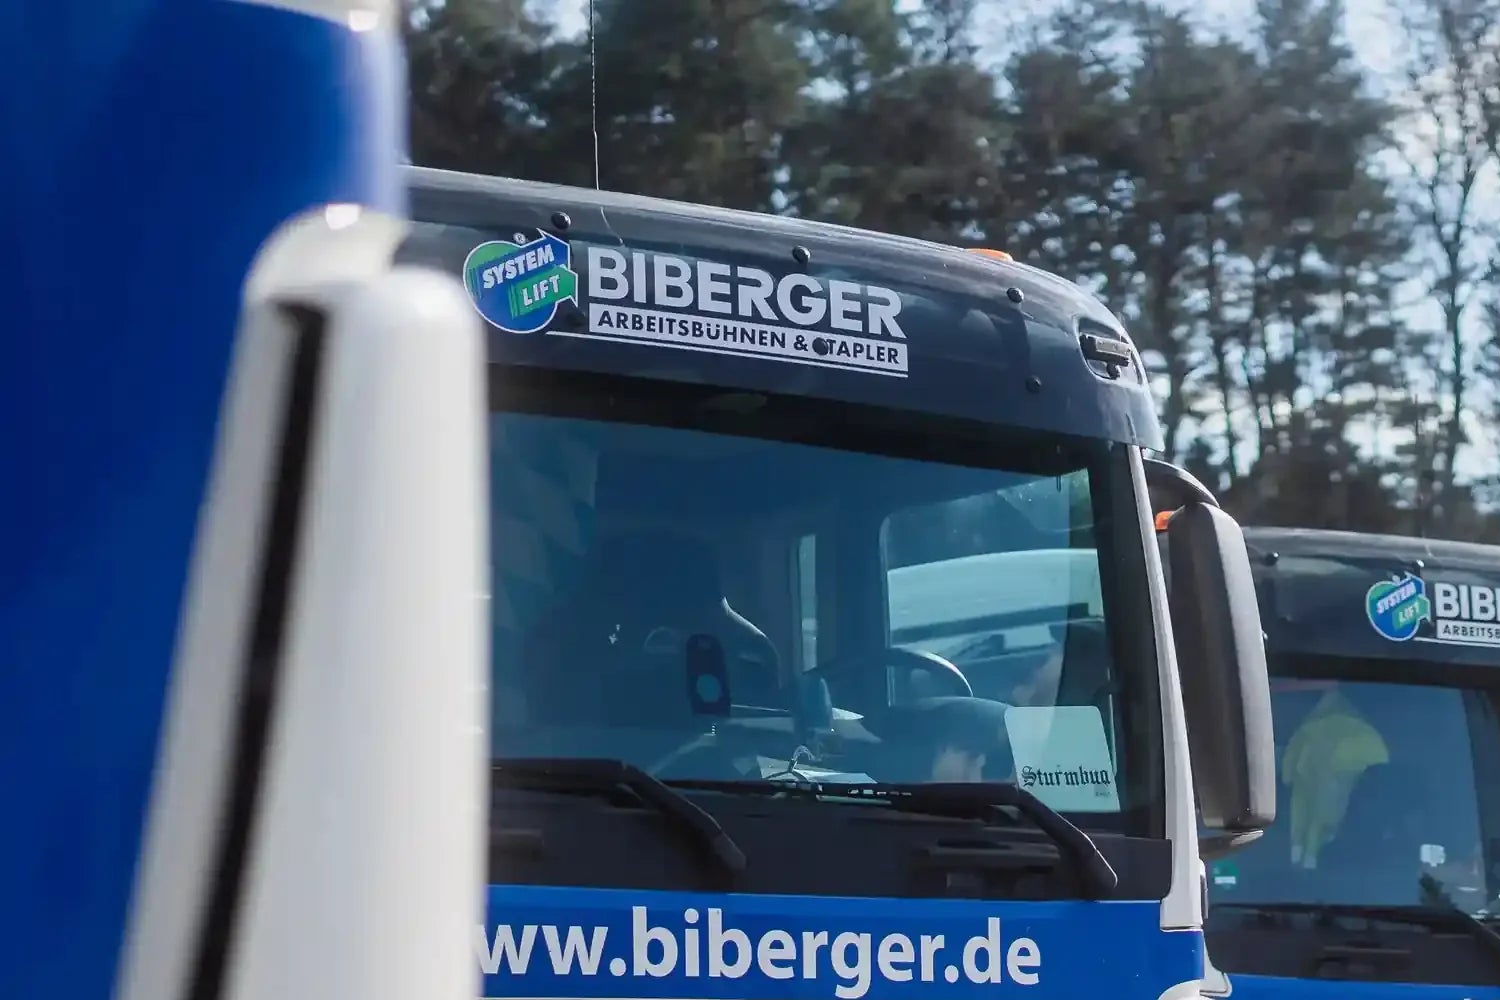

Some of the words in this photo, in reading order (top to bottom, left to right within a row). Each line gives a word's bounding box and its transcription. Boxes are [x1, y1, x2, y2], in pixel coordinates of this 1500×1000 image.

[482, 244, 555, 289] SYSTEM
[522, 274, 560, 306] LIFT
[588, 246, 907, 339] BIBERGER
[598, 310, 786, 349] ARBEITSBÜHNEN
[793, 334, 809, 352] &
[813, 337, 900, 364] TAPLER
[474, 905, 1041, 999] ww.biberger.de
